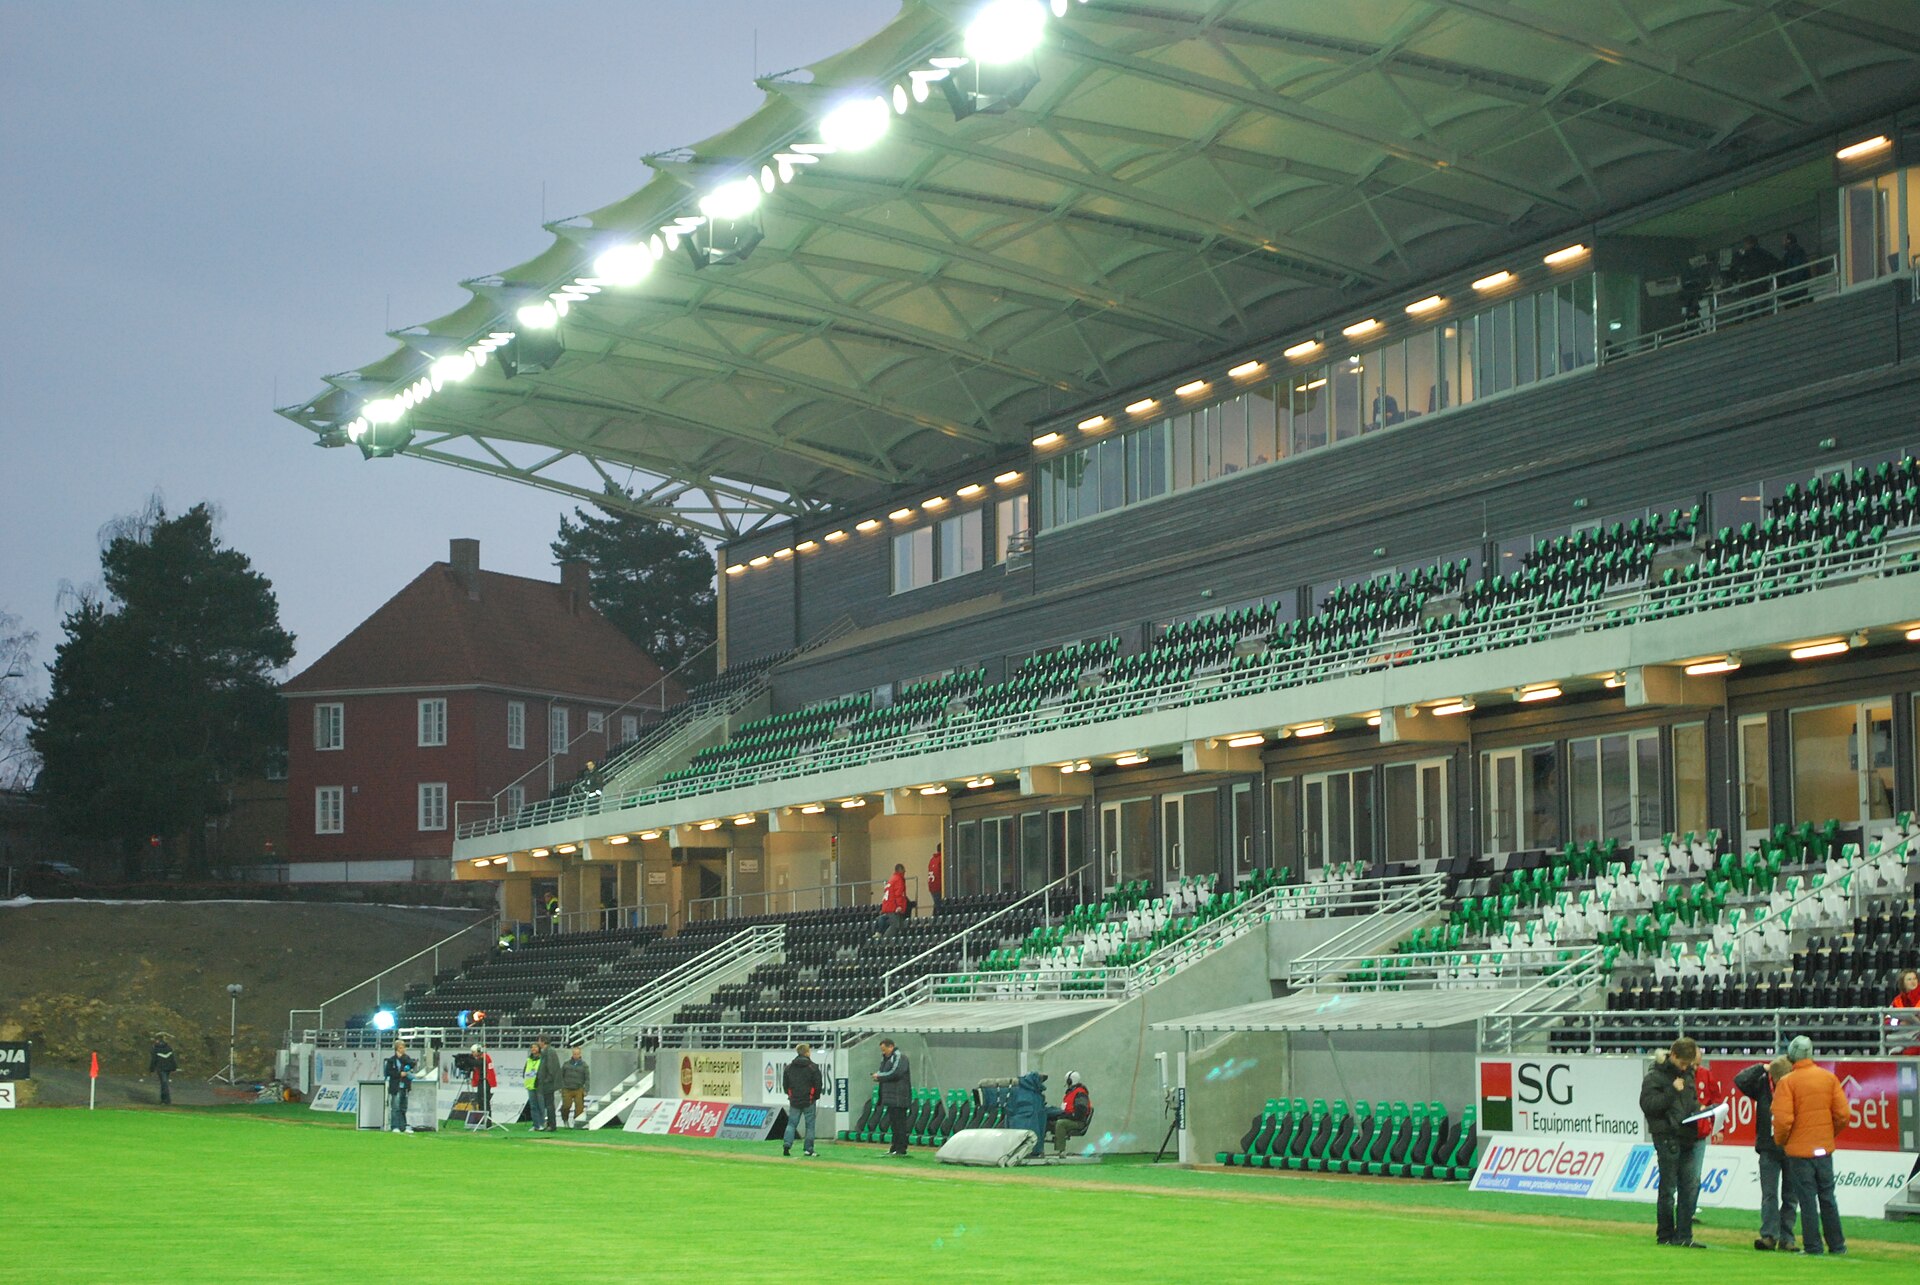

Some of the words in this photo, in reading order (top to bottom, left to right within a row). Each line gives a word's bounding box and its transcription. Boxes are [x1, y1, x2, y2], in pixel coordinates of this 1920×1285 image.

[0, 1049, 25, 1063] DIA
[1518, 1062, 1574, 1106] SG
[1532, 1112, 1592, 1135] Equipment
[1595, 1114, 1639, 1135] Finance
[1492, 1141, 1605, 1178] proclean
[1699, 1168, 1729, 1193] AS
[1833, 1171, 1884, 1188] dsBehov
[1884, 1174, 1905, 1189] AS
